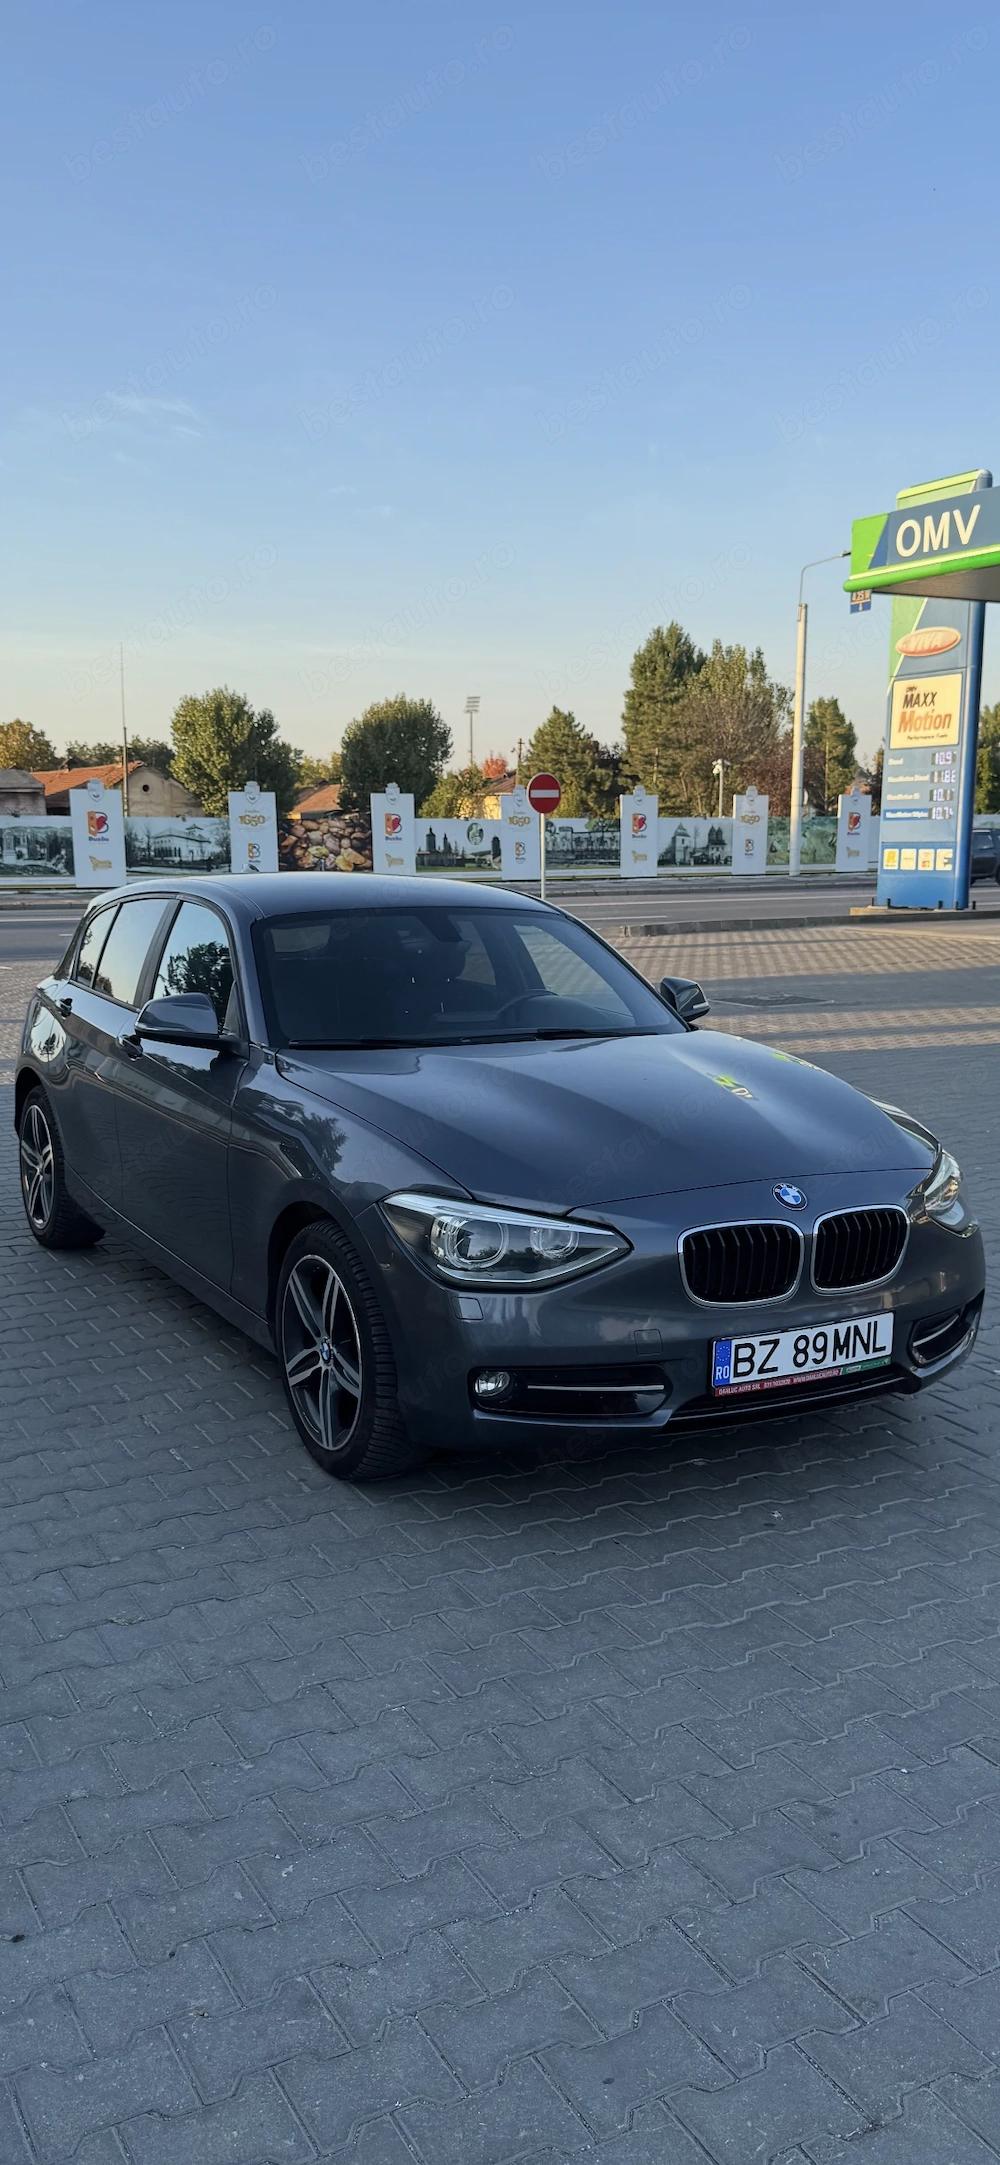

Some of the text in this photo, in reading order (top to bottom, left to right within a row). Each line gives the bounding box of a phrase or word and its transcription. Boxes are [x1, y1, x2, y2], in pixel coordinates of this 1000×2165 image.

[896, 503, 981, 558] OMV
[902, 692, 937, 709] MAXX
[898, 709, 952, 733] Motion
[733, 1320, 886, 1379] BZ 89 MNL
[715, 1365, 730, 1380] RO
